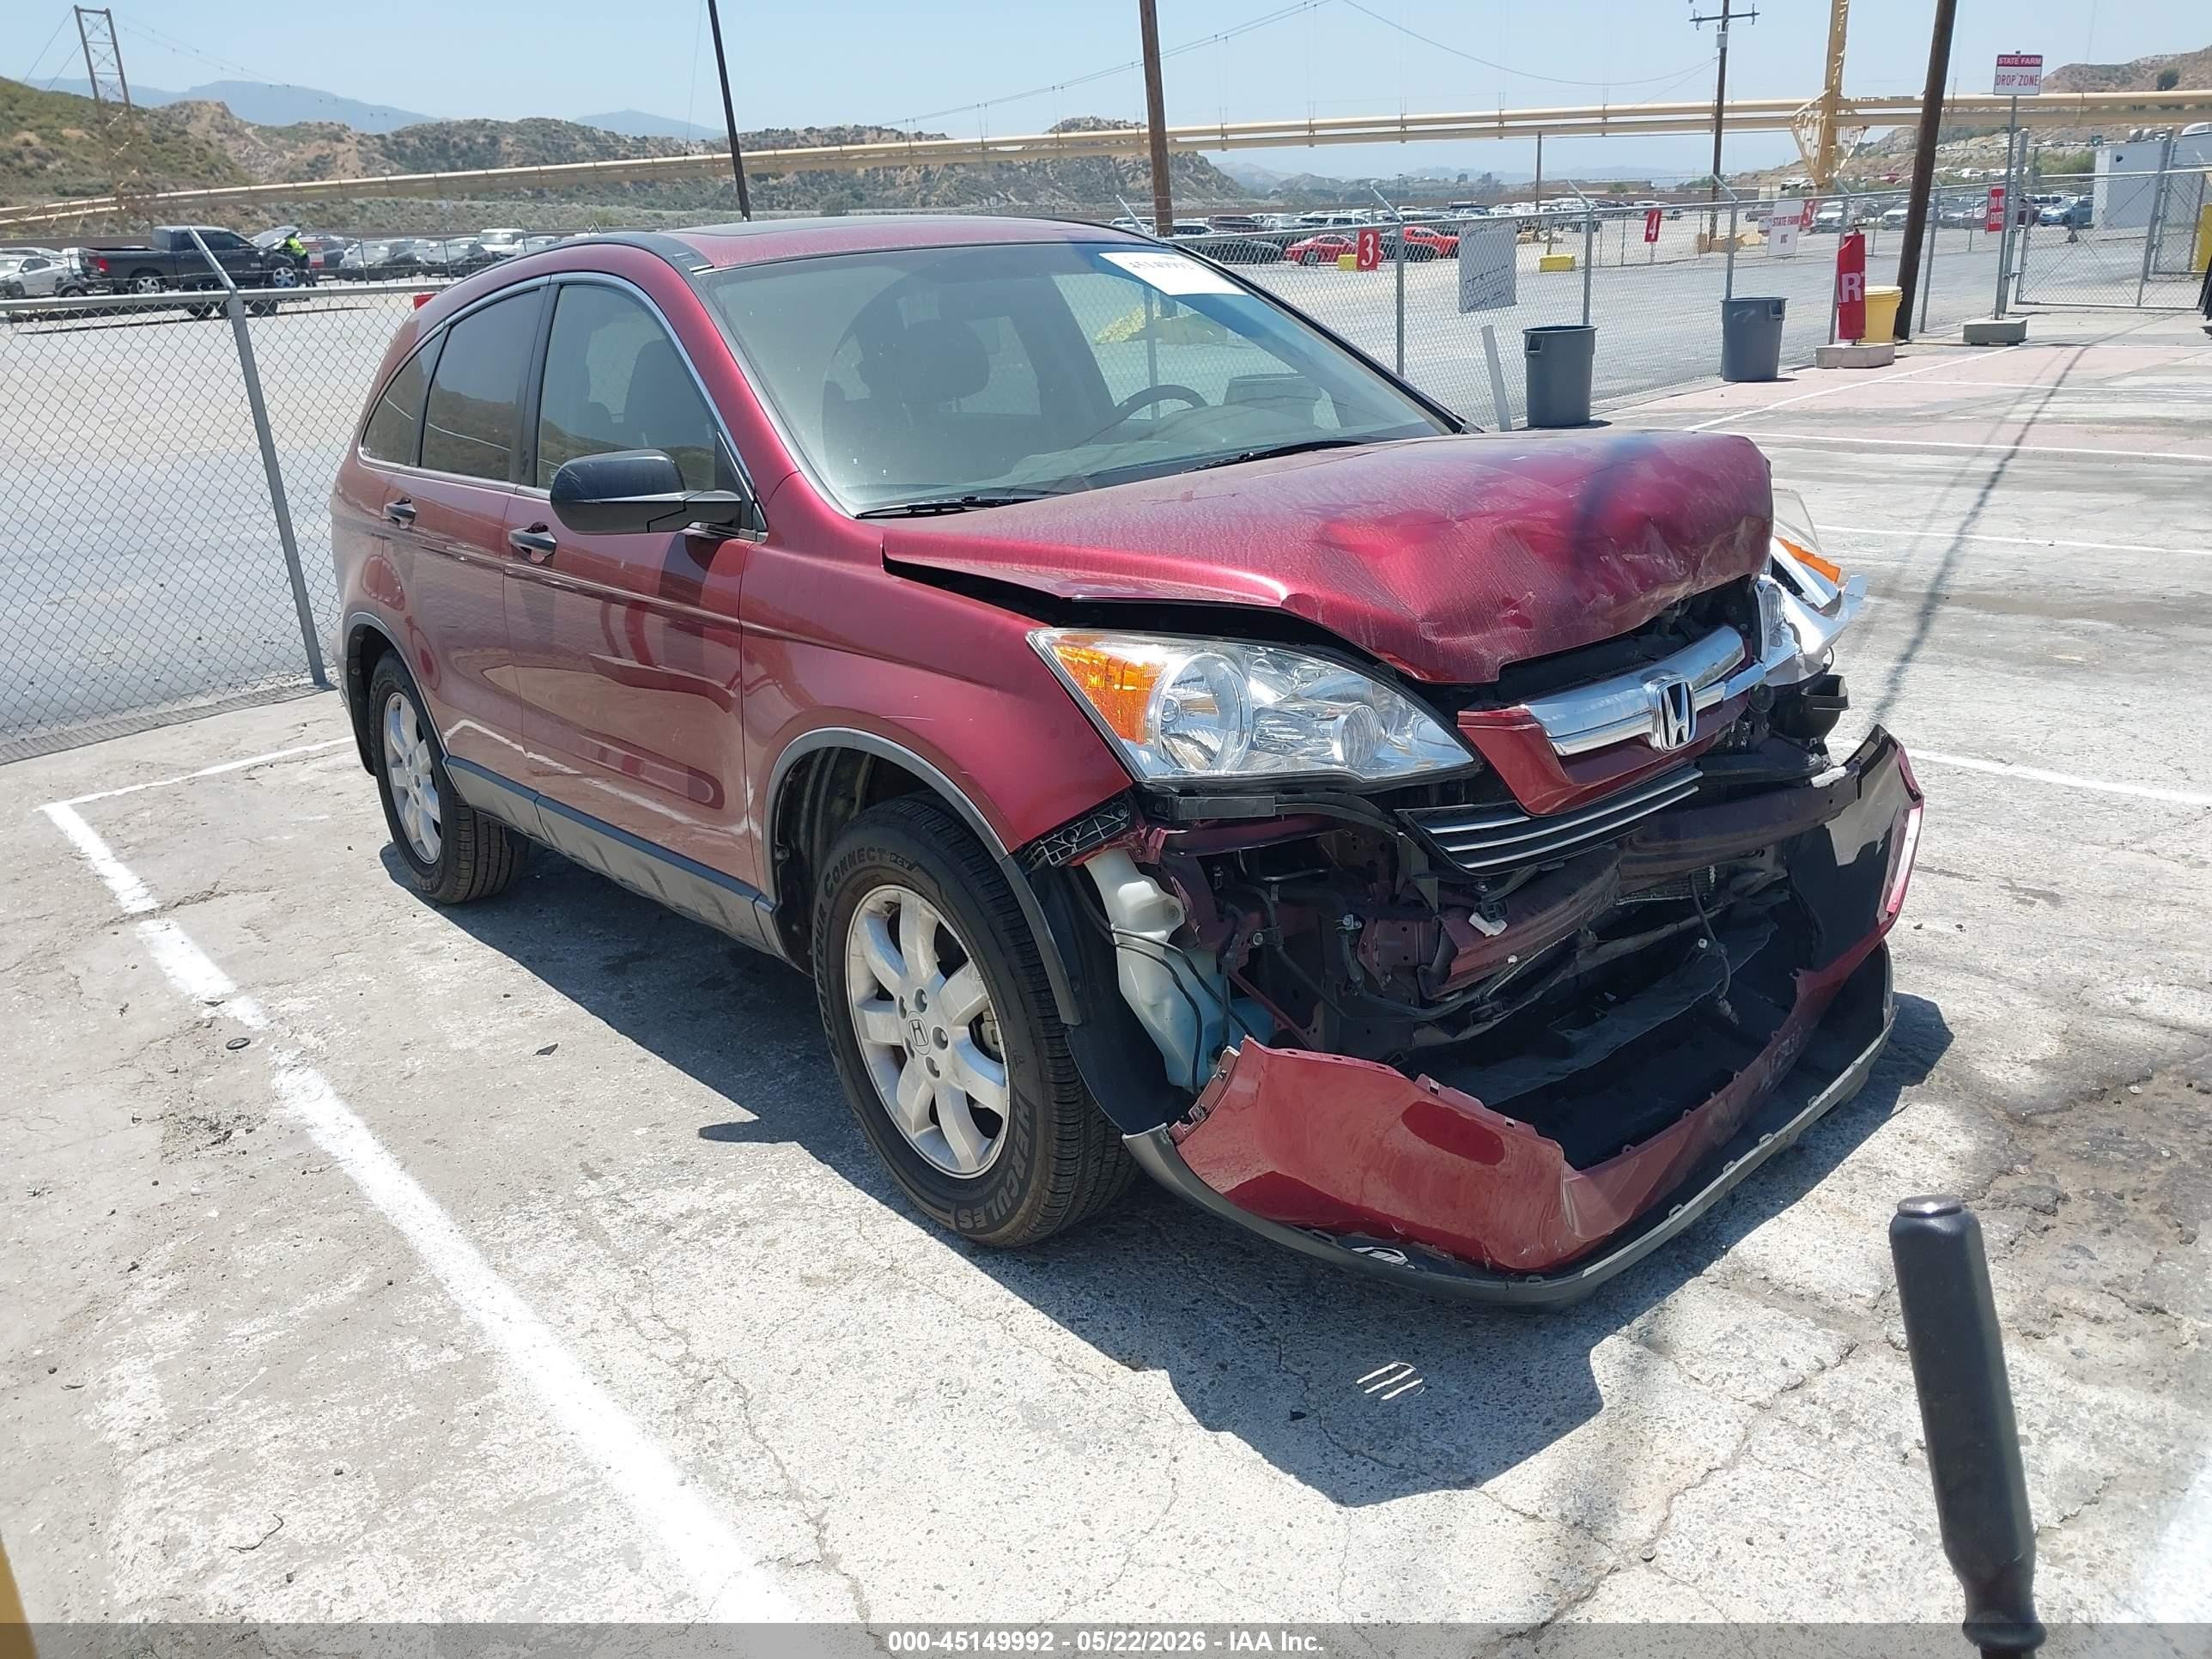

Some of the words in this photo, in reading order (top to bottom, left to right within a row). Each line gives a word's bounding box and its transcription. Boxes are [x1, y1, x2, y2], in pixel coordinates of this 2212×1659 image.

[1998, 57, 2020, 65] STATE
[2021, 57, 2041, 65] FARM
[1996, 75, 2016, 86] DROP
[2018, 75, 2039, 86] ZONE
[1648, 212, 1659, 240] 4
[1772, 216, 1787, 227] STATE
[1990, 211, 2003, 224] ENTE
[1361, 233, 1374, 266] 3
[824, 845, 888, 899] CONNECT
[957, 1092, 1031, 1230] HERCULES
